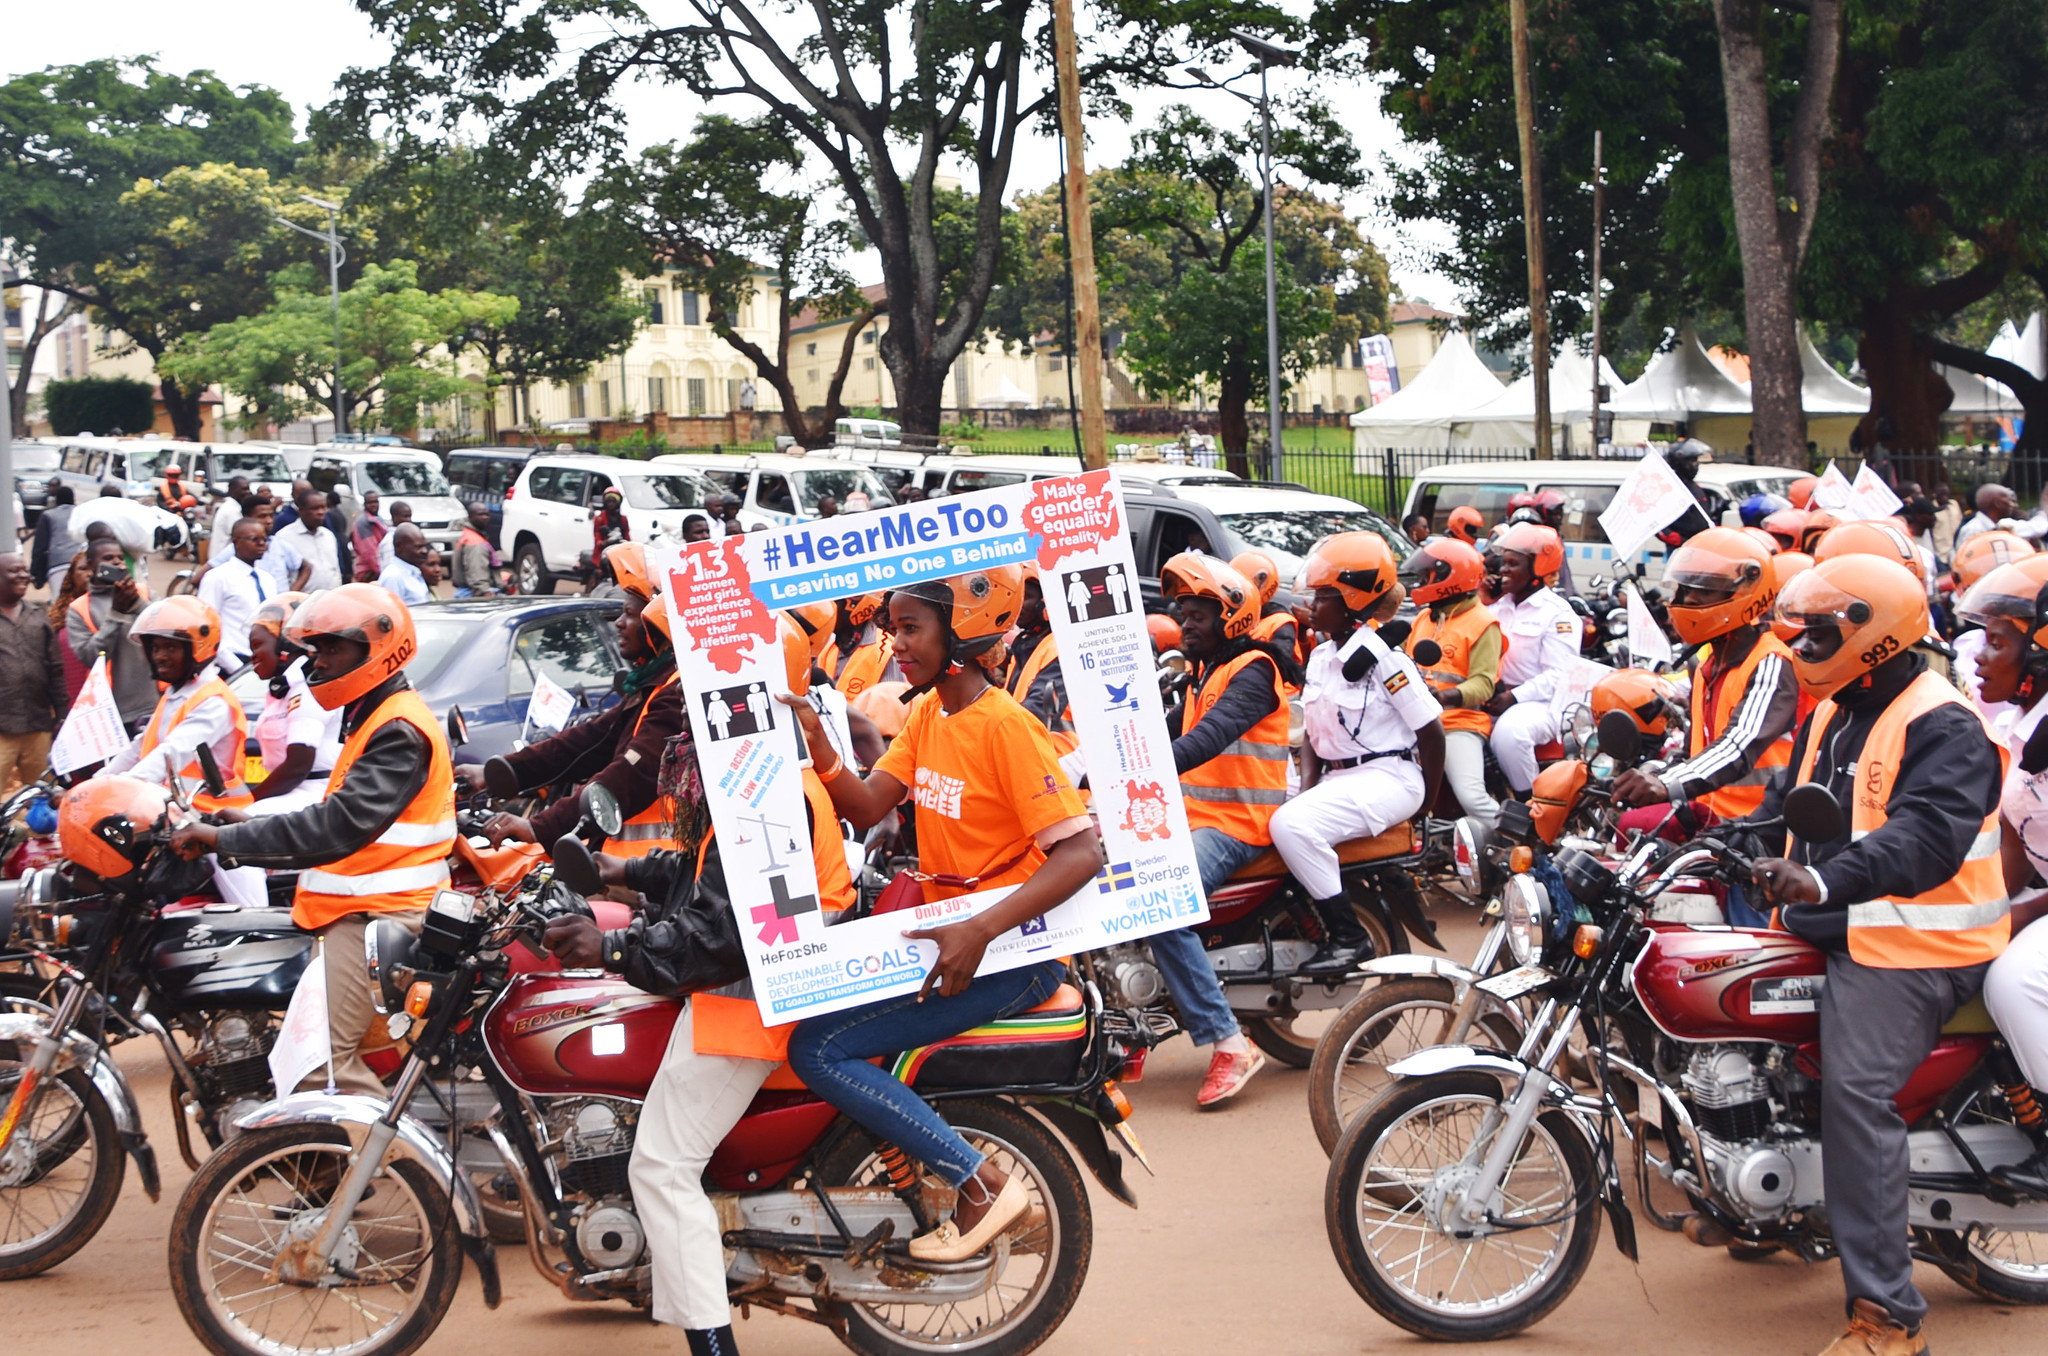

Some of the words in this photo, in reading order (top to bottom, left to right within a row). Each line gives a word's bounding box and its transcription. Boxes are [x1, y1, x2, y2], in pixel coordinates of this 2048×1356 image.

[1042, 481, 1086, 500] Make
[1030, 494, 1104, 524] gender
[1043, 510, 1112, 536] equality
[763, 502, 1009, 571] #HearMeToo
[1049, 539, 1058, 549] a
[1059, 531, 1100, 547] reality
[687, 552, 705, 582] 1
[704, 568, 716, 580] in
[707, 549, 729, 578] 3
[770, 569, 859, 601] Leaving
[864, 563, 896, 582] No
[901, 551, 946, 575] One
[952, 536, 1027, 566] Behind
[689, 577, 736, 593] women
[689, 592, 713, 605] and
[714, 587, 741, 603] girls
[683, 597, 751, 618] experience
[687, 610, 739, 628] violence
[740, 608, 753, 618] in
[706, 622, 737, 636] their
[1084, 626, 1115, 638] UNITING
[1227, 612, 1254, 638] 7209
[700, 633, 749, 648] lifetime
[1078, 637, 1110, 649] ACHIEVE
[1111, 634, 1127, 643] SDG
[1118, 642, 1140, 653] JUSTICE
[1860, 635, 1900, 668] 993
[381, 637, 414, 676] 2102
[1079, 652, 1095, 671] 16
[1099, 658, 1111, 667] AND
[1111, 654, 1134, 665] STRONG
[1101, 663, 1139, 676] INSTITUTIONS
[718, 769, 736, 790] What
[729, 739, 754, 771] action
[739, 779, 757, 801] Law
[1134, 855, 1167, 868] Sweden
[1138, 864, 1190, 885] Sverige
[914, 903, 942, 920] Only
[944, 896, 972, 914] 30%
[1140, 888, 1169, 908] UN
[1101, 905, 1173, 934] WOMEN
[988, 936, 1043, 955] NORWEGIAN
[1045, 926, 1085, 943] EMBASSY
[760, 942, 828, 966] HeForShe
[845, 944, 922, 978] GOALS
[766, 960, 844, 988] SUSTAINABLE
[768, 973, 845, 999] DEVELOPMENT
[774, 1001, 785, 1011] 17
[785, 996, 813, 1009] GOALD
[814, 991, 826, 1001] TO
[826, 979, 875, 999] TRANSFORM
[874, 976, 893, 987] OUR
[892, 969, 922, 983] WORLD
[513, 1003, 593, 1034] BOXER
